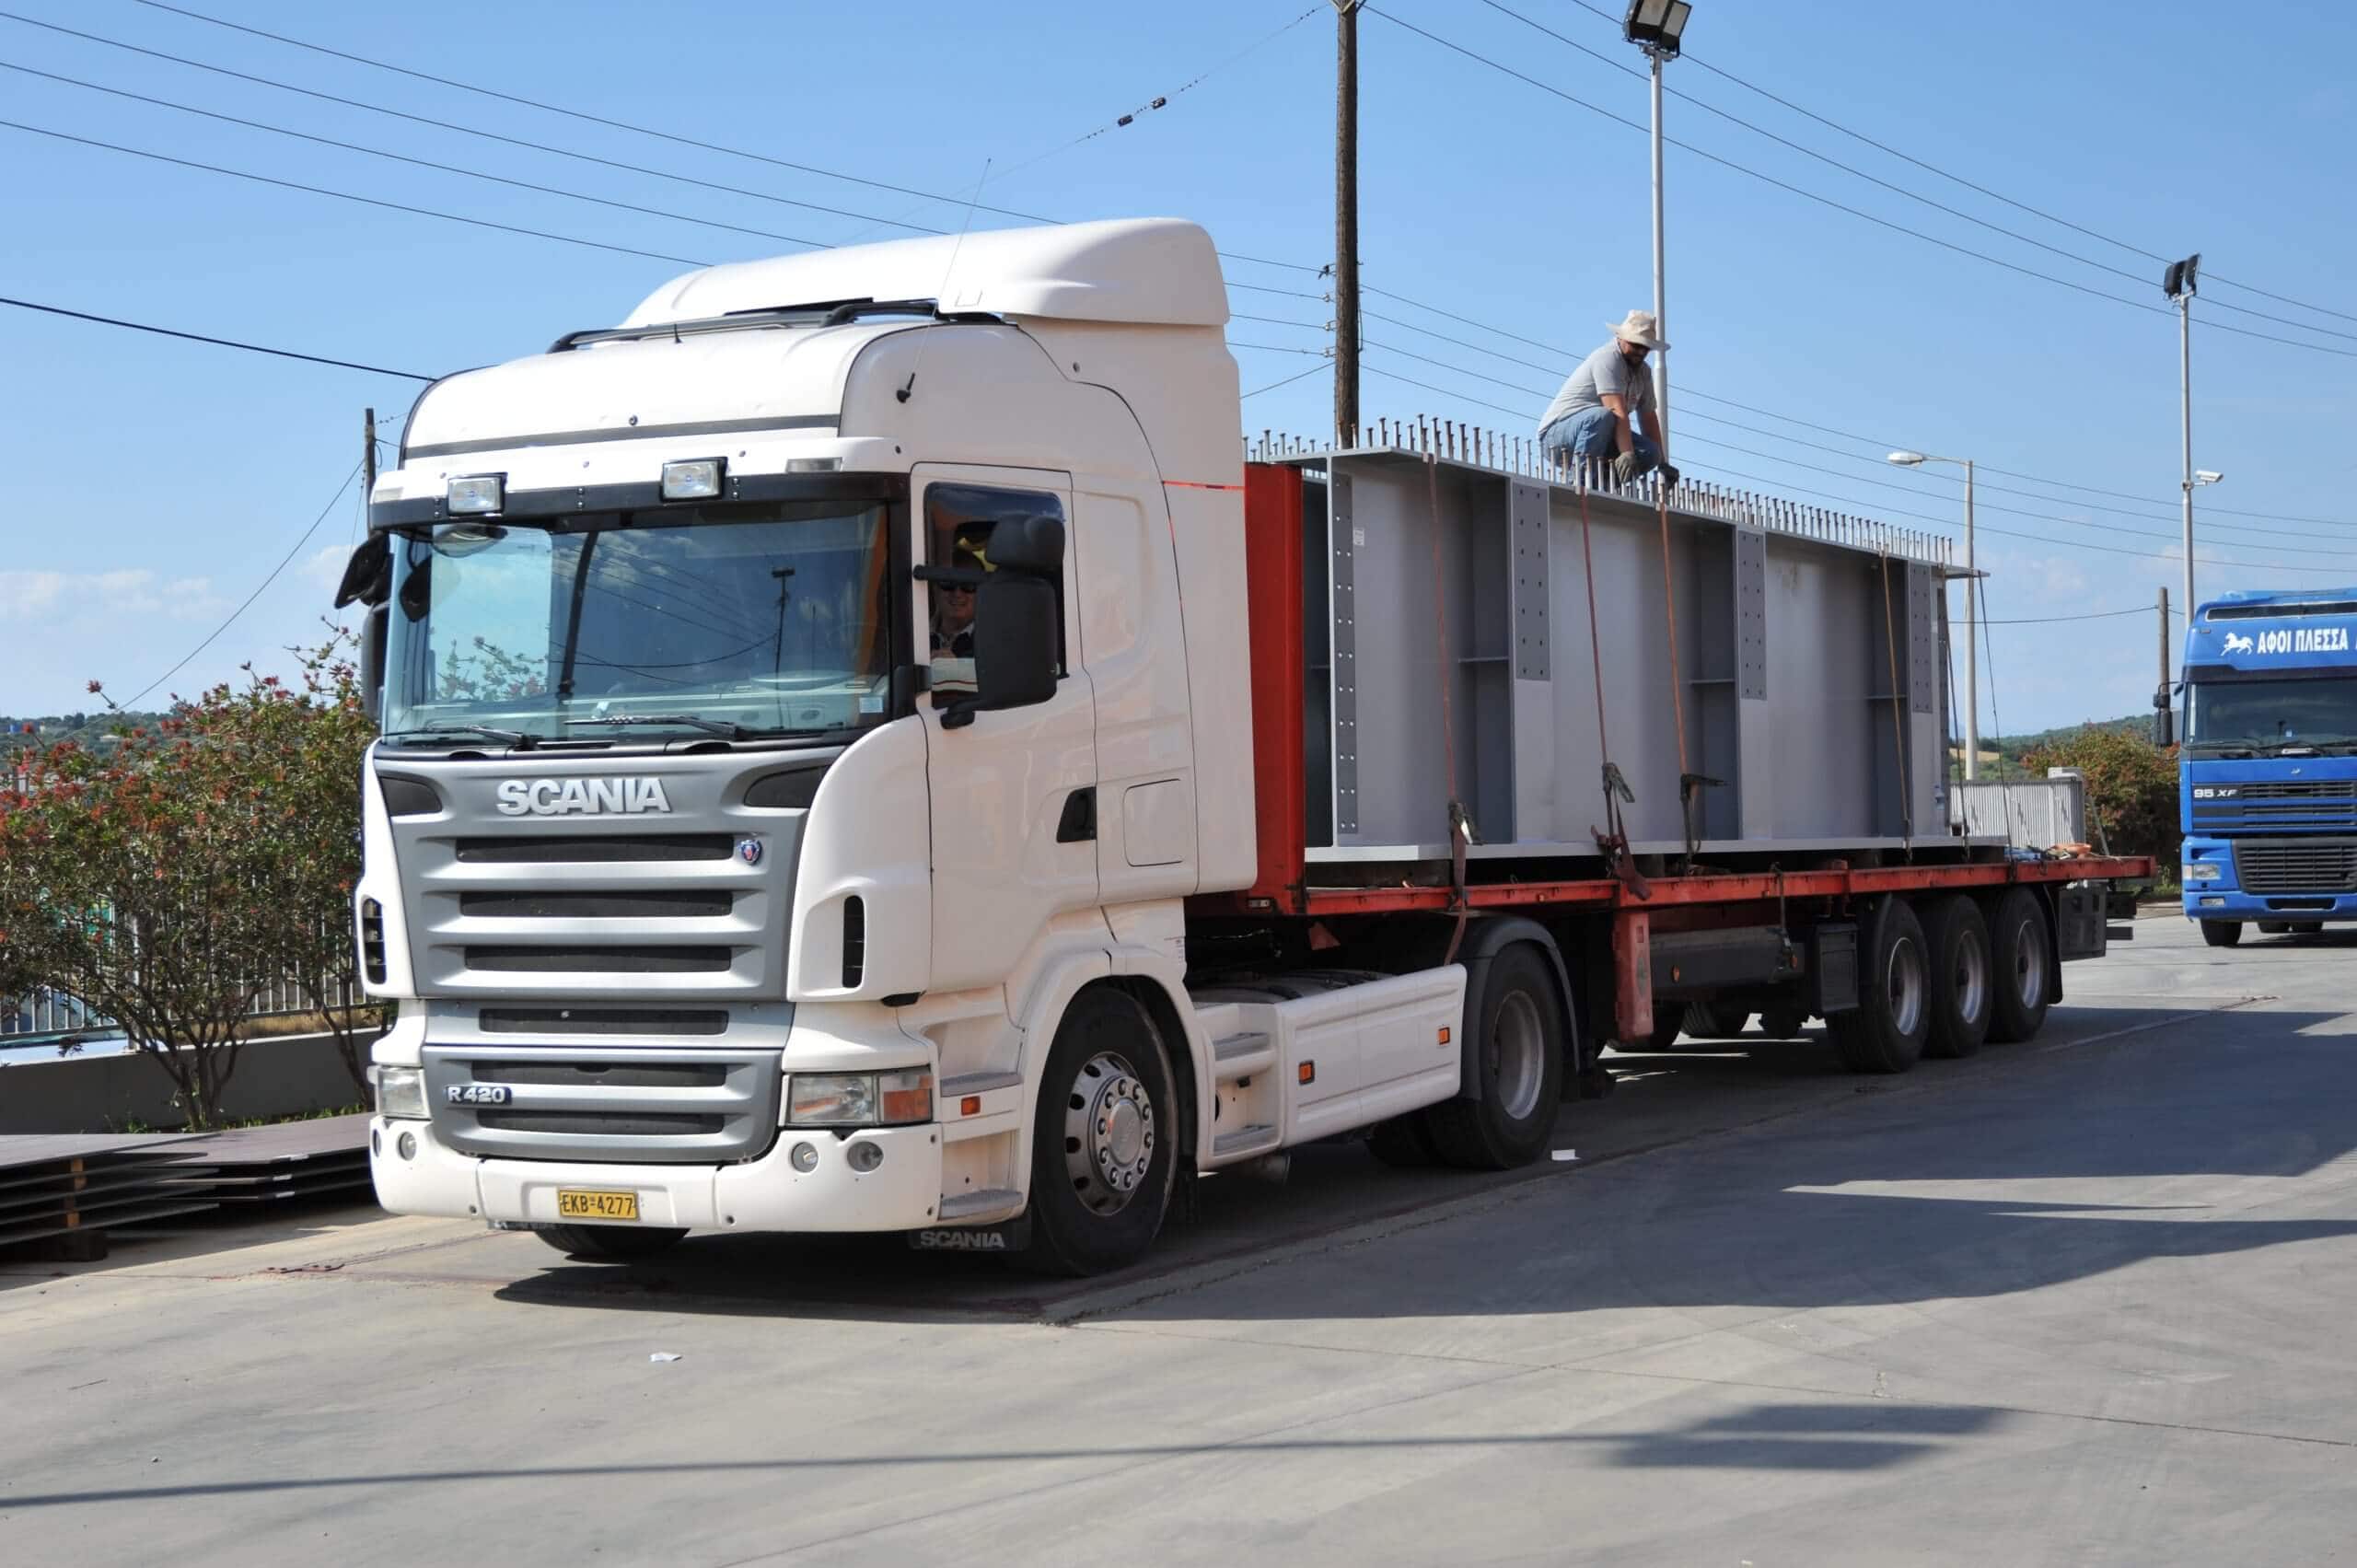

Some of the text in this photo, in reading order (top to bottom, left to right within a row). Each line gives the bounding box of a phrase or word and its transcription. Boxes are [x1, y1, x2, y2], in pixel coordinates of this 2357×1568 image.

[2257, 631, 2292, 654] ΑΦΟΙ
[2295, 628, 2348, 652] ΠΛΕΣΣΑ
[496, 777, 671, 816] SCANIA
[2194, 788, 2237, 798] 95 XF
[447, 1086, 505, 1103] R 420
[920, 1231, 1005, 1249] SCANIA
